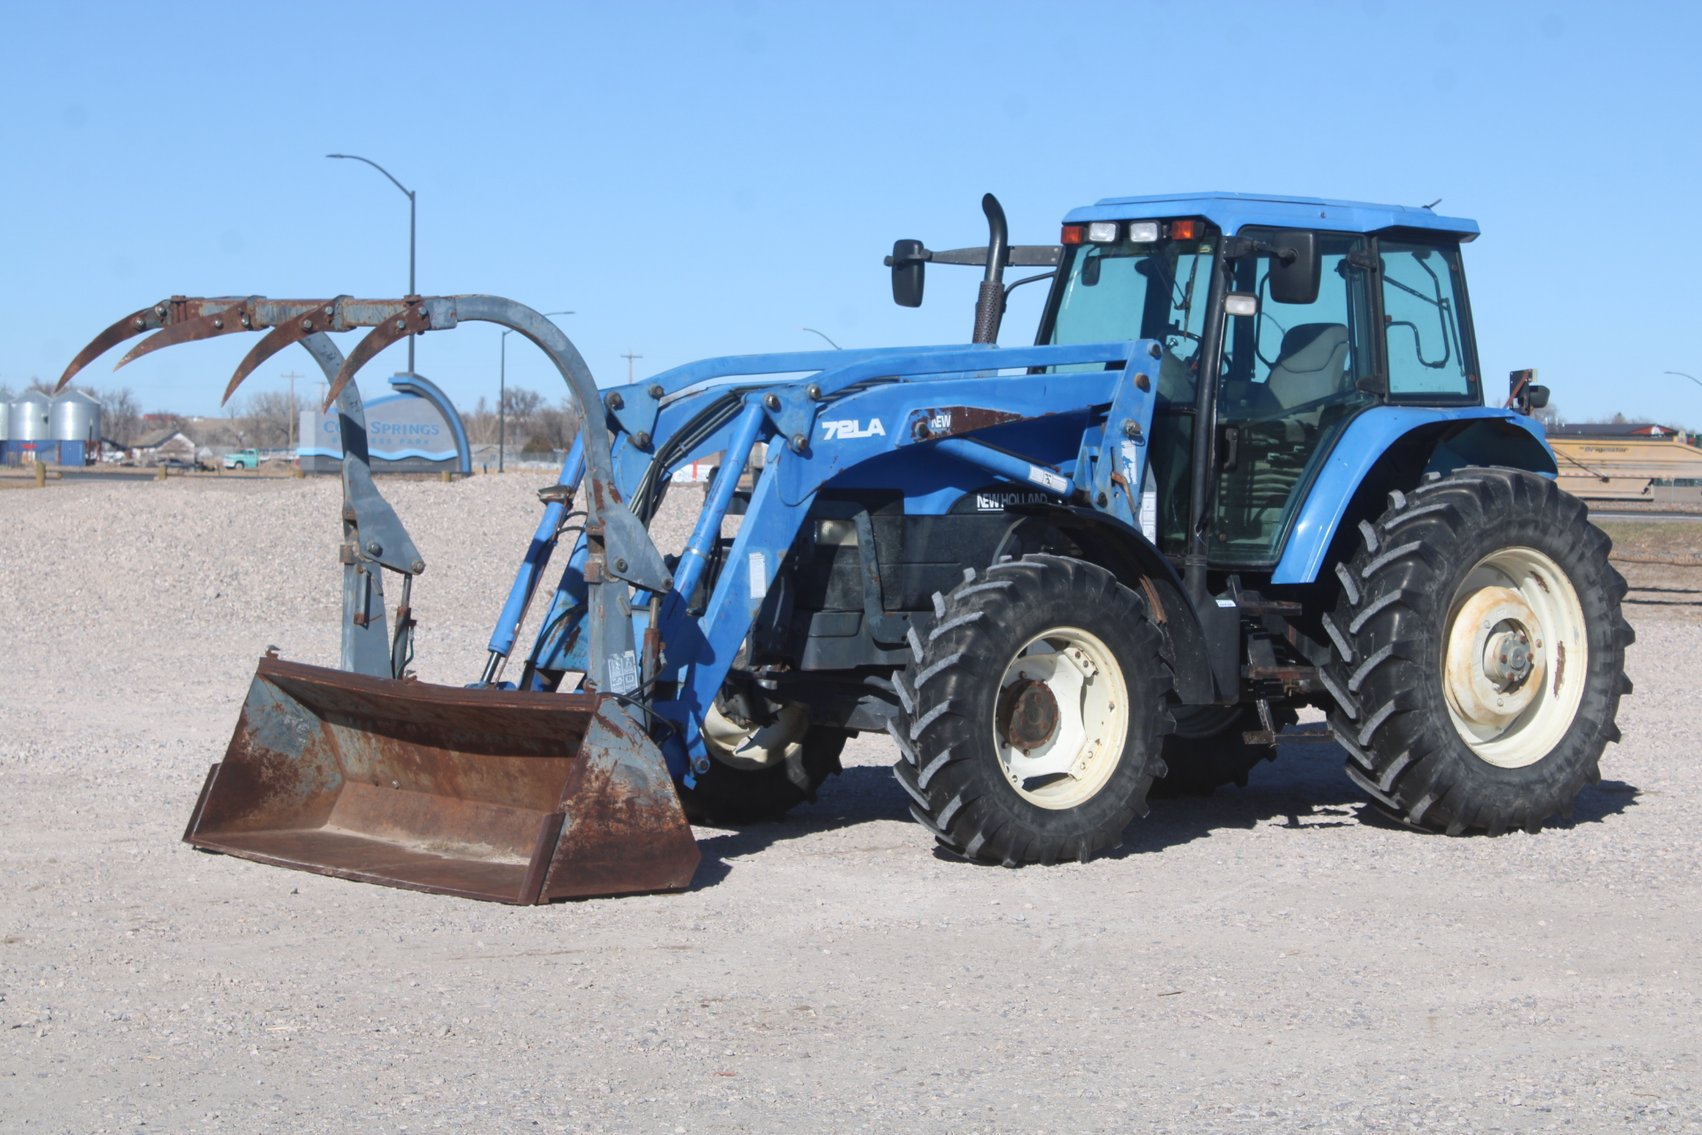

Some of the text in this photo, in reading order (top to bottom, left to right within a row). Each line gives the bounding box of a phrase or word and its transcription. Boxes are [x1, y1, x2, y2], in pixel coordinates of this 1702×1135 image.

[370, 421, 440, 435] SPRINGS
[930, 414, 952, 428] NEW
[822, 418, 886, 440] 72LA
[976, 492, 1047, 508] NEW HOLLAND
